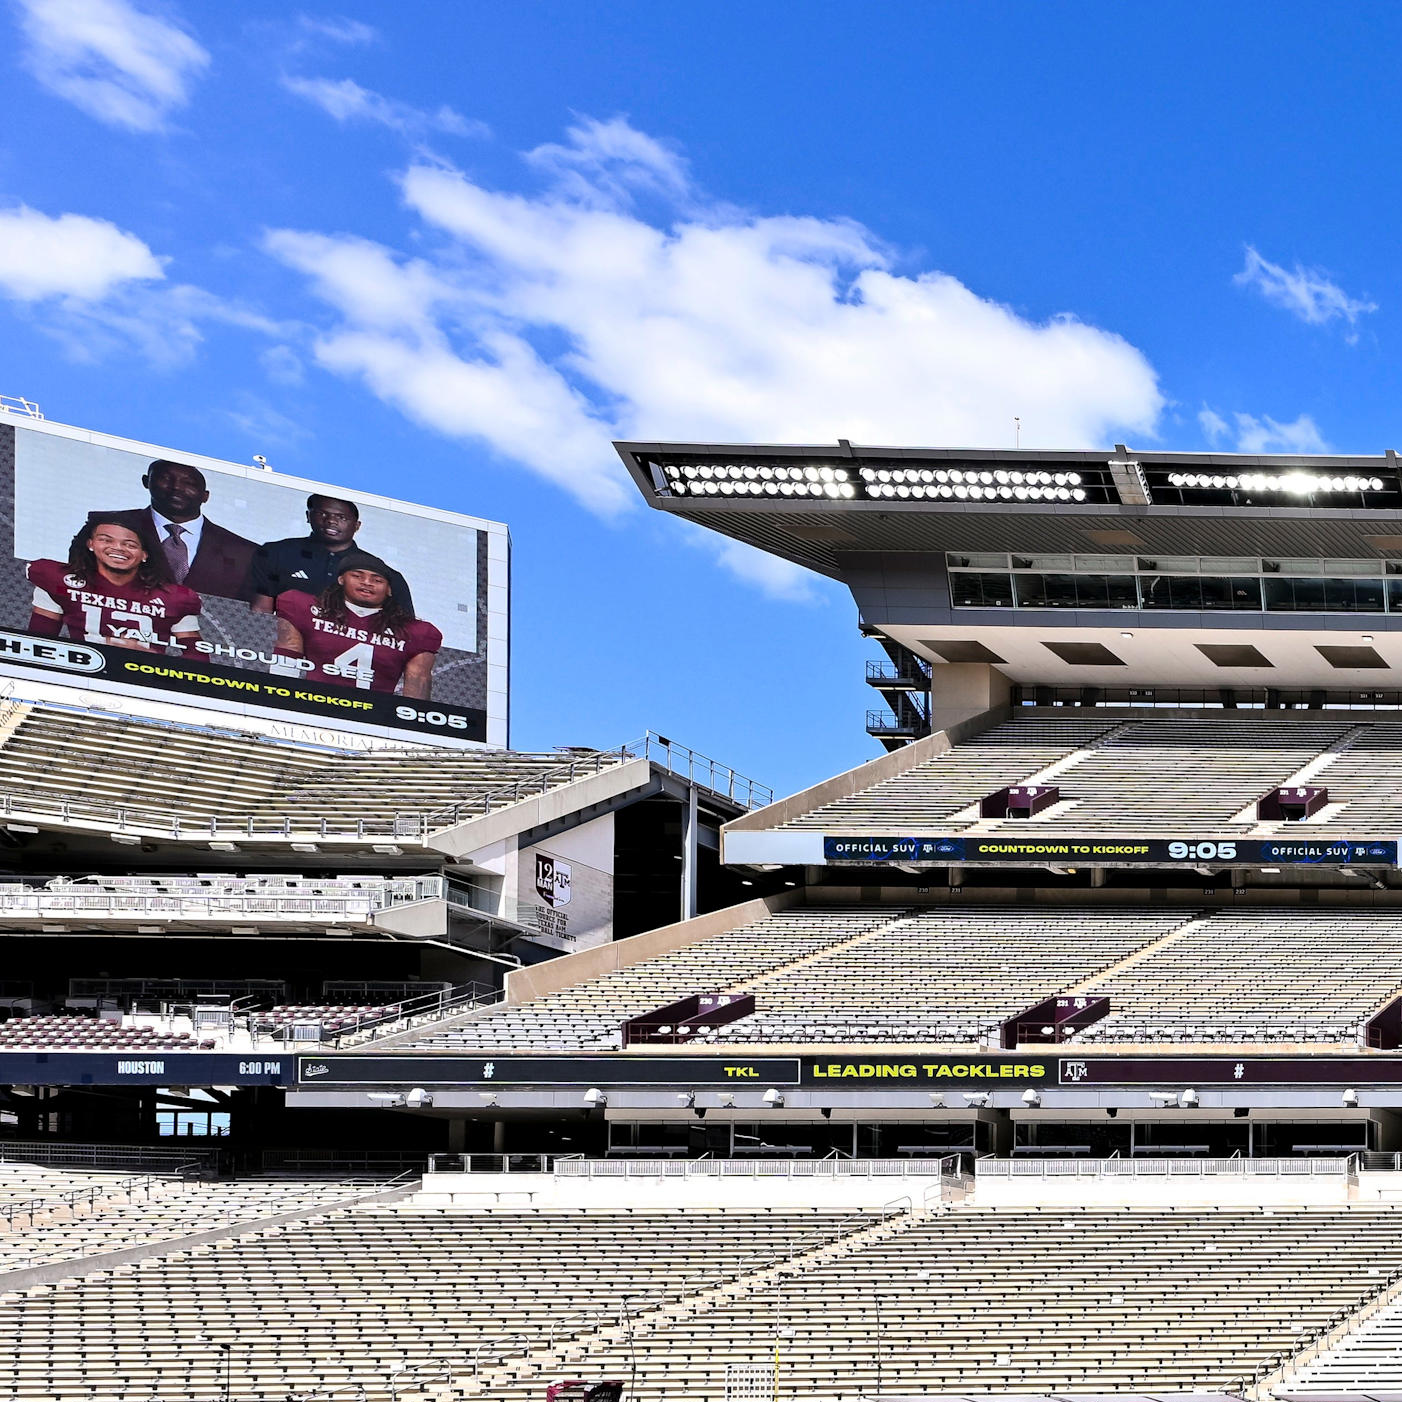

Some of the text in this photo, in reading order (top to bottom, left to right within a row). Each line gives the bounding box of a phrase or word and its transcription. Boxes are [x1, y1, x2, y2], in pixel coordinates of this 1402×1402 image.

[67, 589, 166, 618] TEXAS A&M
[0, 639, 92, 666] H-E-B
[195, 640, 315, 671] SHOULD
[322, 663, 375, 683] SEE
[334, 643, 375, 689] 4
[124, 662, 373, 710] COUNTDOWN TO KICKOFF
[395, 706, 468, 729] 9:05
[836, 844, 888, 852] OFFICIAL
[892, 844, 915, 852] SUV
[979, 845, 1148, 854] COUNTDOWN TO KICKOFF
[1168, 842, 1237, 859] 9:05
[1272, 847, 1322, 856] OFFICIAL
[1326, 847, 1348, 856] SUV
[538, 861, 553, 881] 12
[118, 1061, 164, 1074] HOUSTON
[239, 1062, 281, 1074] 6:00 PM
[724, 1067, 760, 1077] TKL
[813, 1064, 1045, 1078] LEADING TACKLERS
